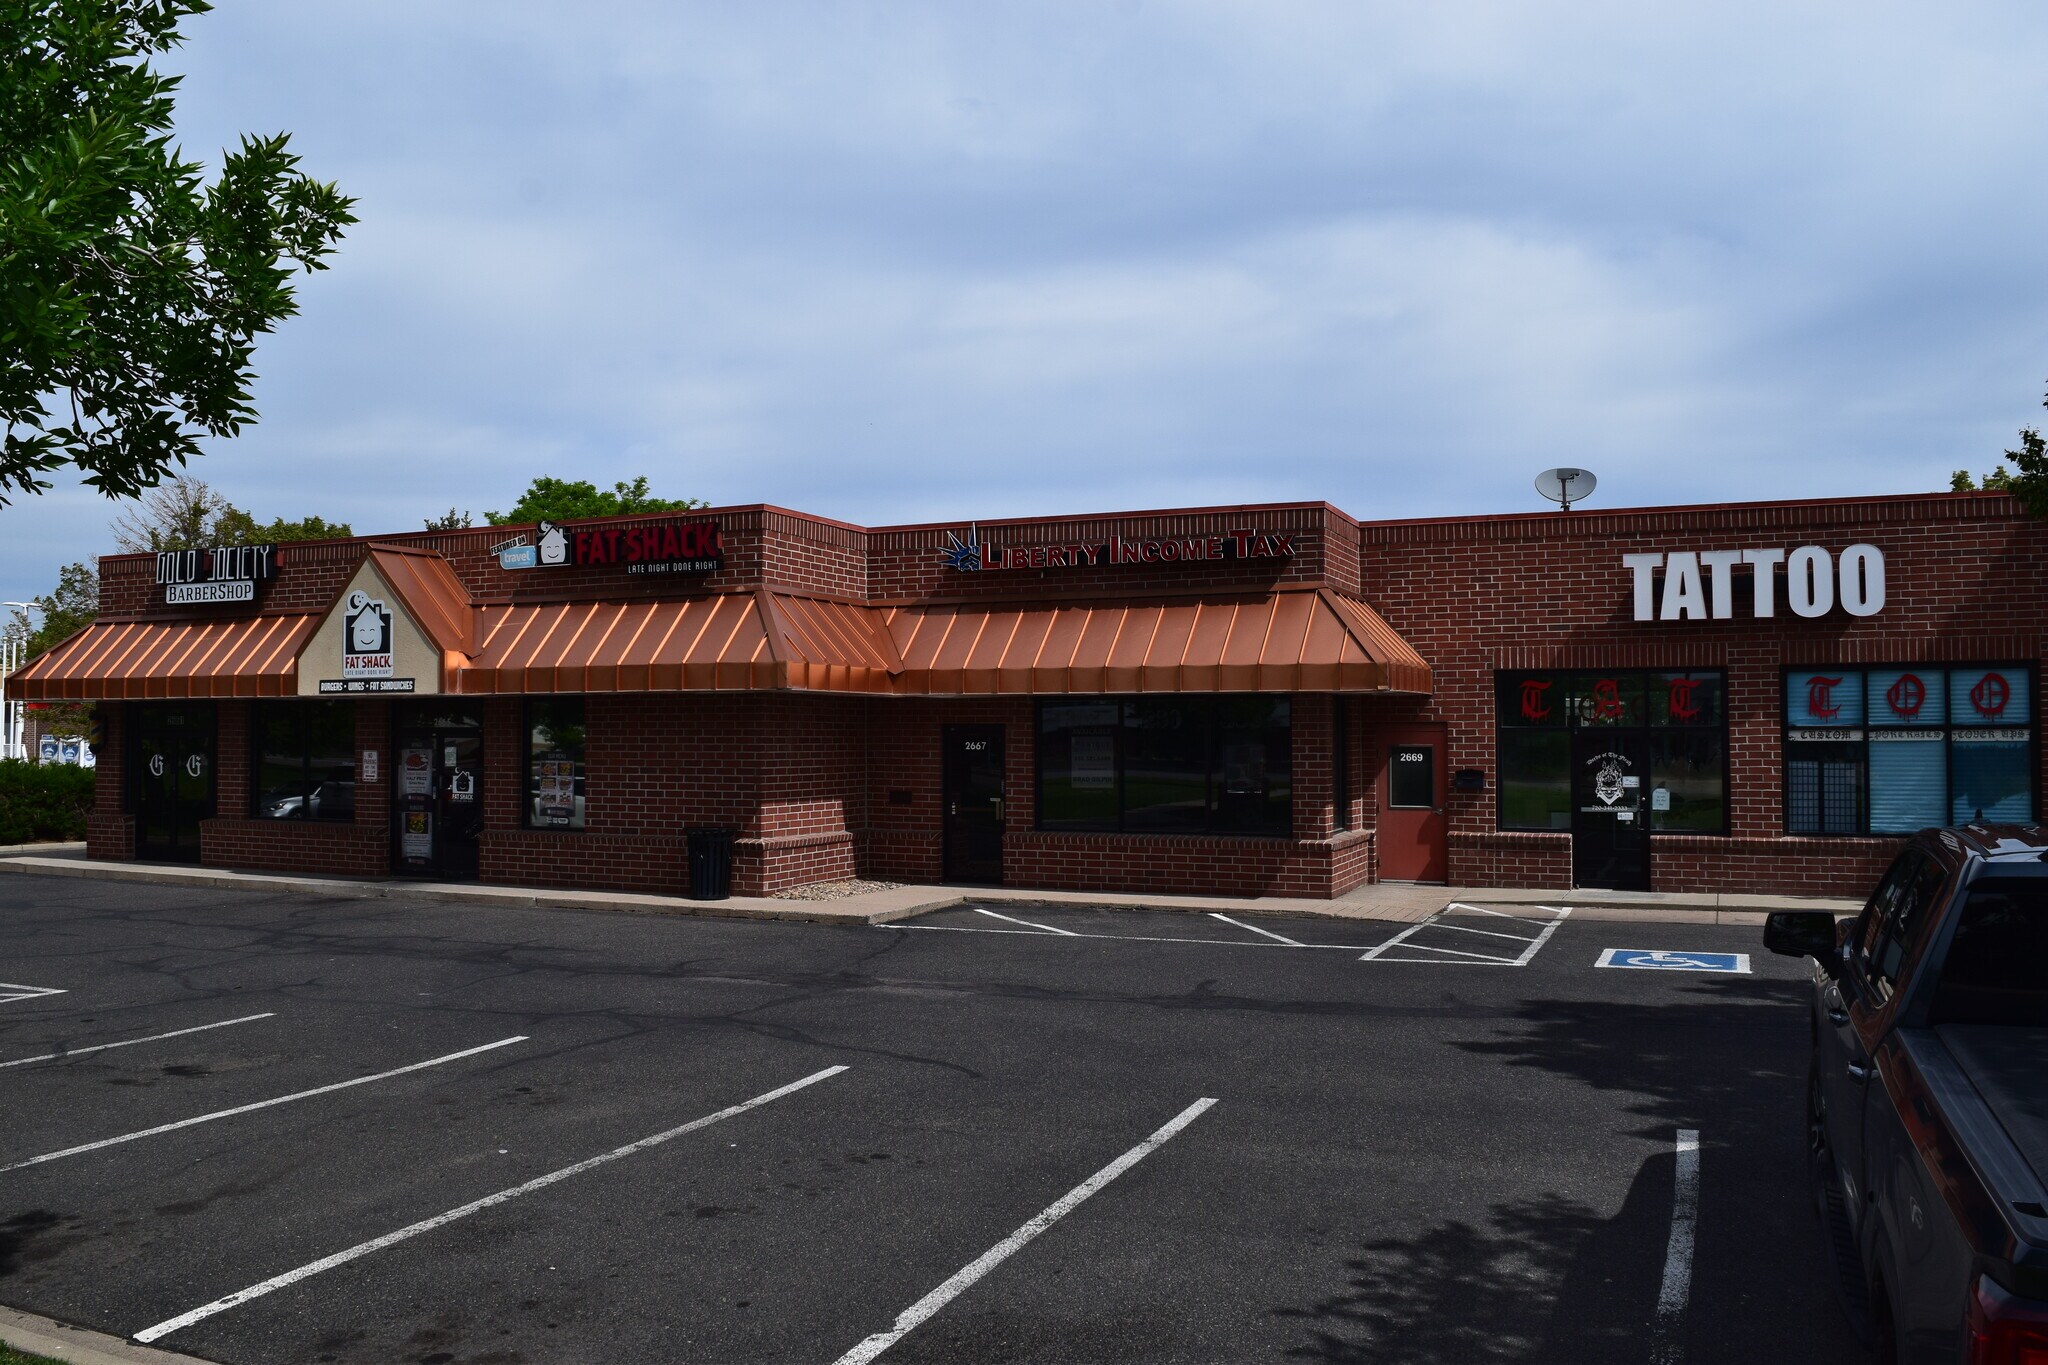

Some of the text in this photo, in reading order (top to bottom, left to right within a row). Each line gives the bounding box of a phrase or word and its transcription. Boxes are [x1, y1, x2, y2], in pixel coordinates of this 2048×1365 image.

[491, 535, 527, 555] FEATURED ON
[575, 523, 718, 565] FAT SHACK
[979, 528, 1296, 571] LIBERTY INCOME TAX
[504, 550, 531, 563] travel
[156, 545, 270, 584] GOLD SOCIETY
[628, 561, 717, 574] LATE NIGHT DONE RIGHT
[1622, 543, 1886, 621] TATTOO
[345, 655, 391, 669] FAT SHACK
[369, 682, 379, 691] FAT
[1799, 730, 1852, 740] CUSTOM
[965, 741, 987, 751] 2667
[1400, 752, 1424, 762] 2669
